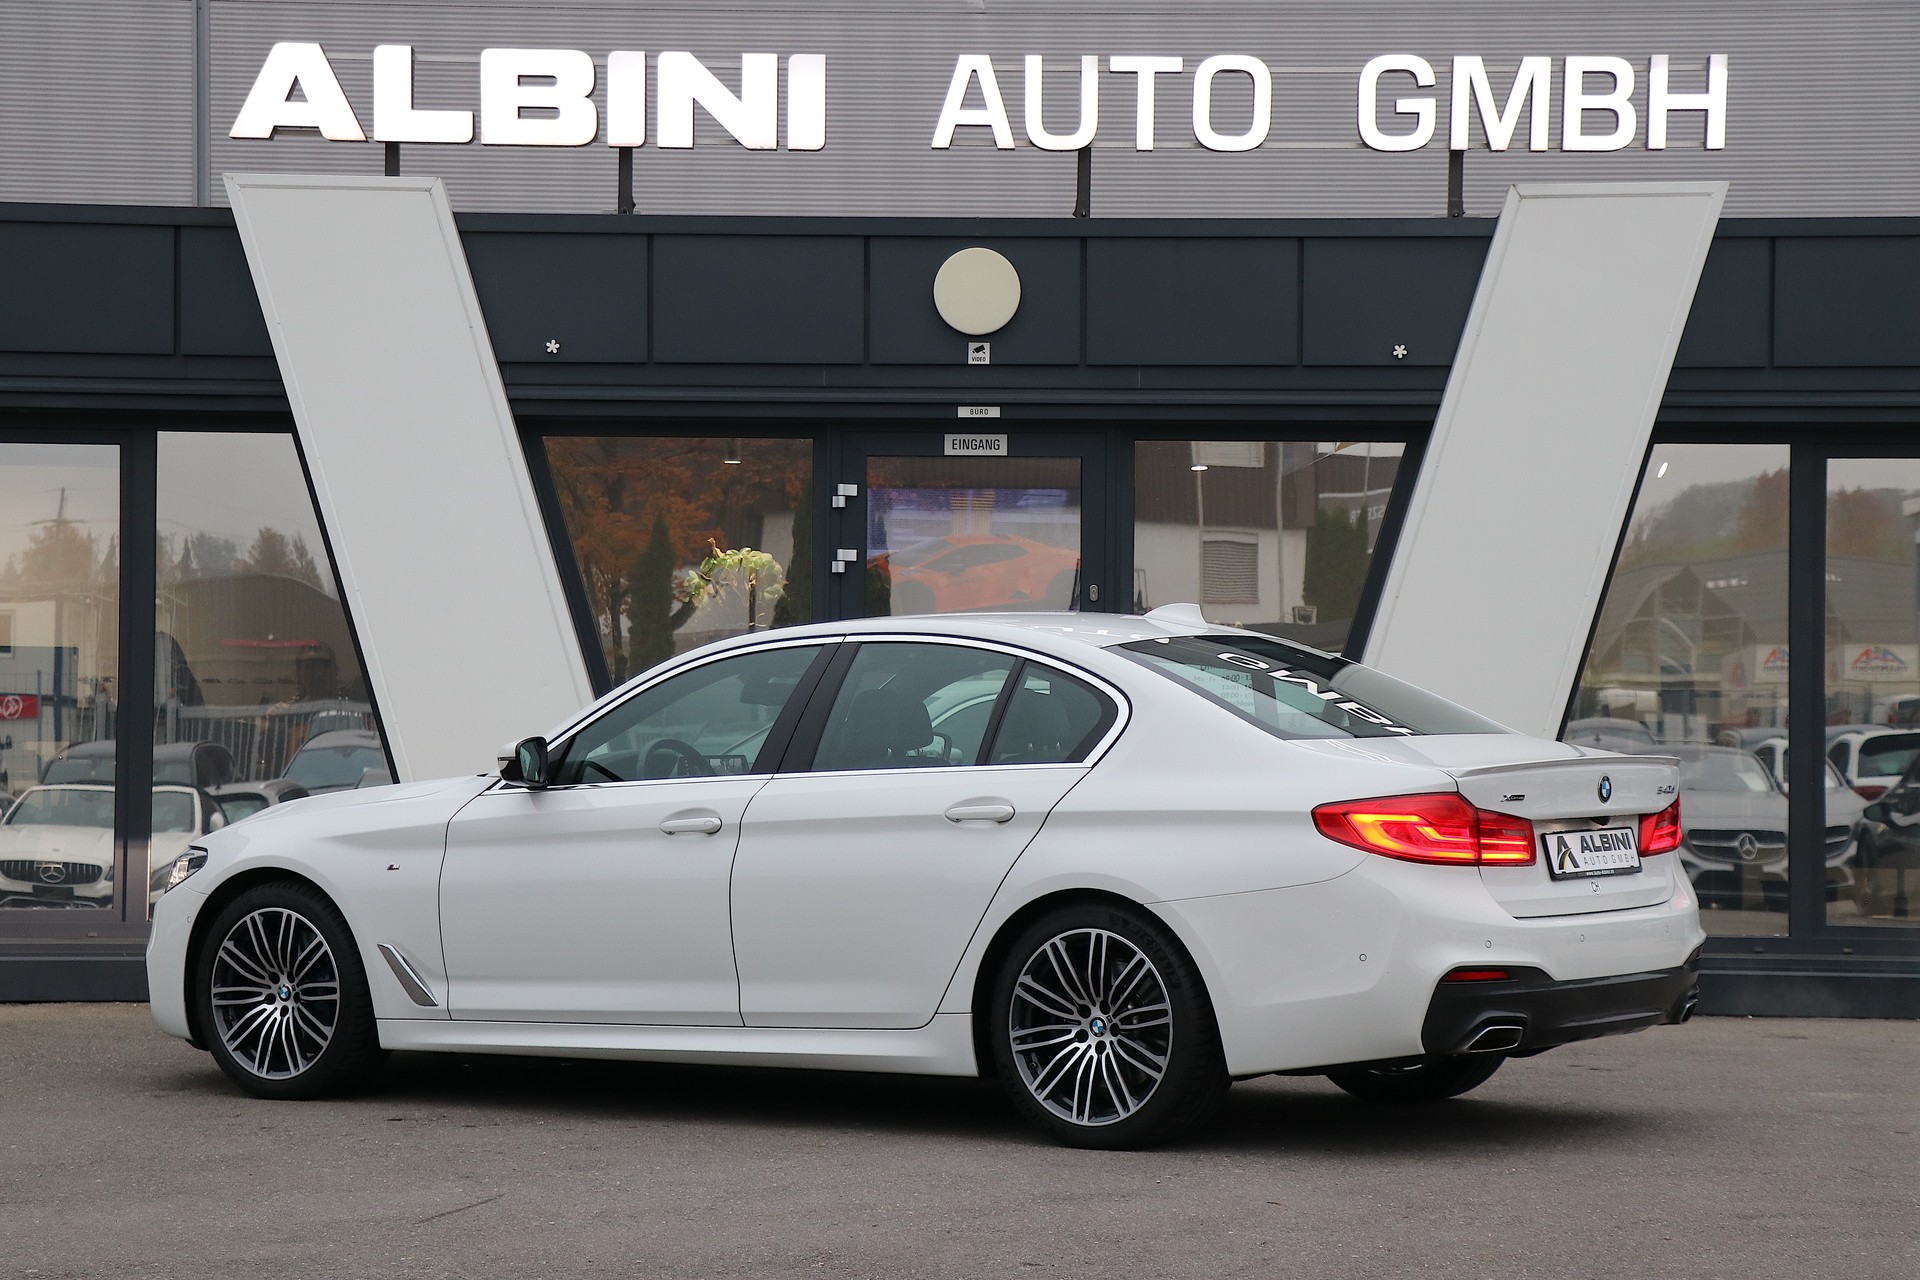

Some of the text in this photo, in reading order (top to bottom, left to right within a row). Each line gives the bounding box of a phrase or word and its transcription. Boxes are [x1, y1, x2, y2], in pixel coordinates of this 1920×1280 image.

[228, 42, 1729, 152] ALBINI AUTO GMBH
[969, 407, 989, 416] BÜRO
[951, 438, 1001, 451] EINGANG
[1580, 832, 1632, 853] ALBINI
[1583, 853, 1636, 866] AUTO GMBH
